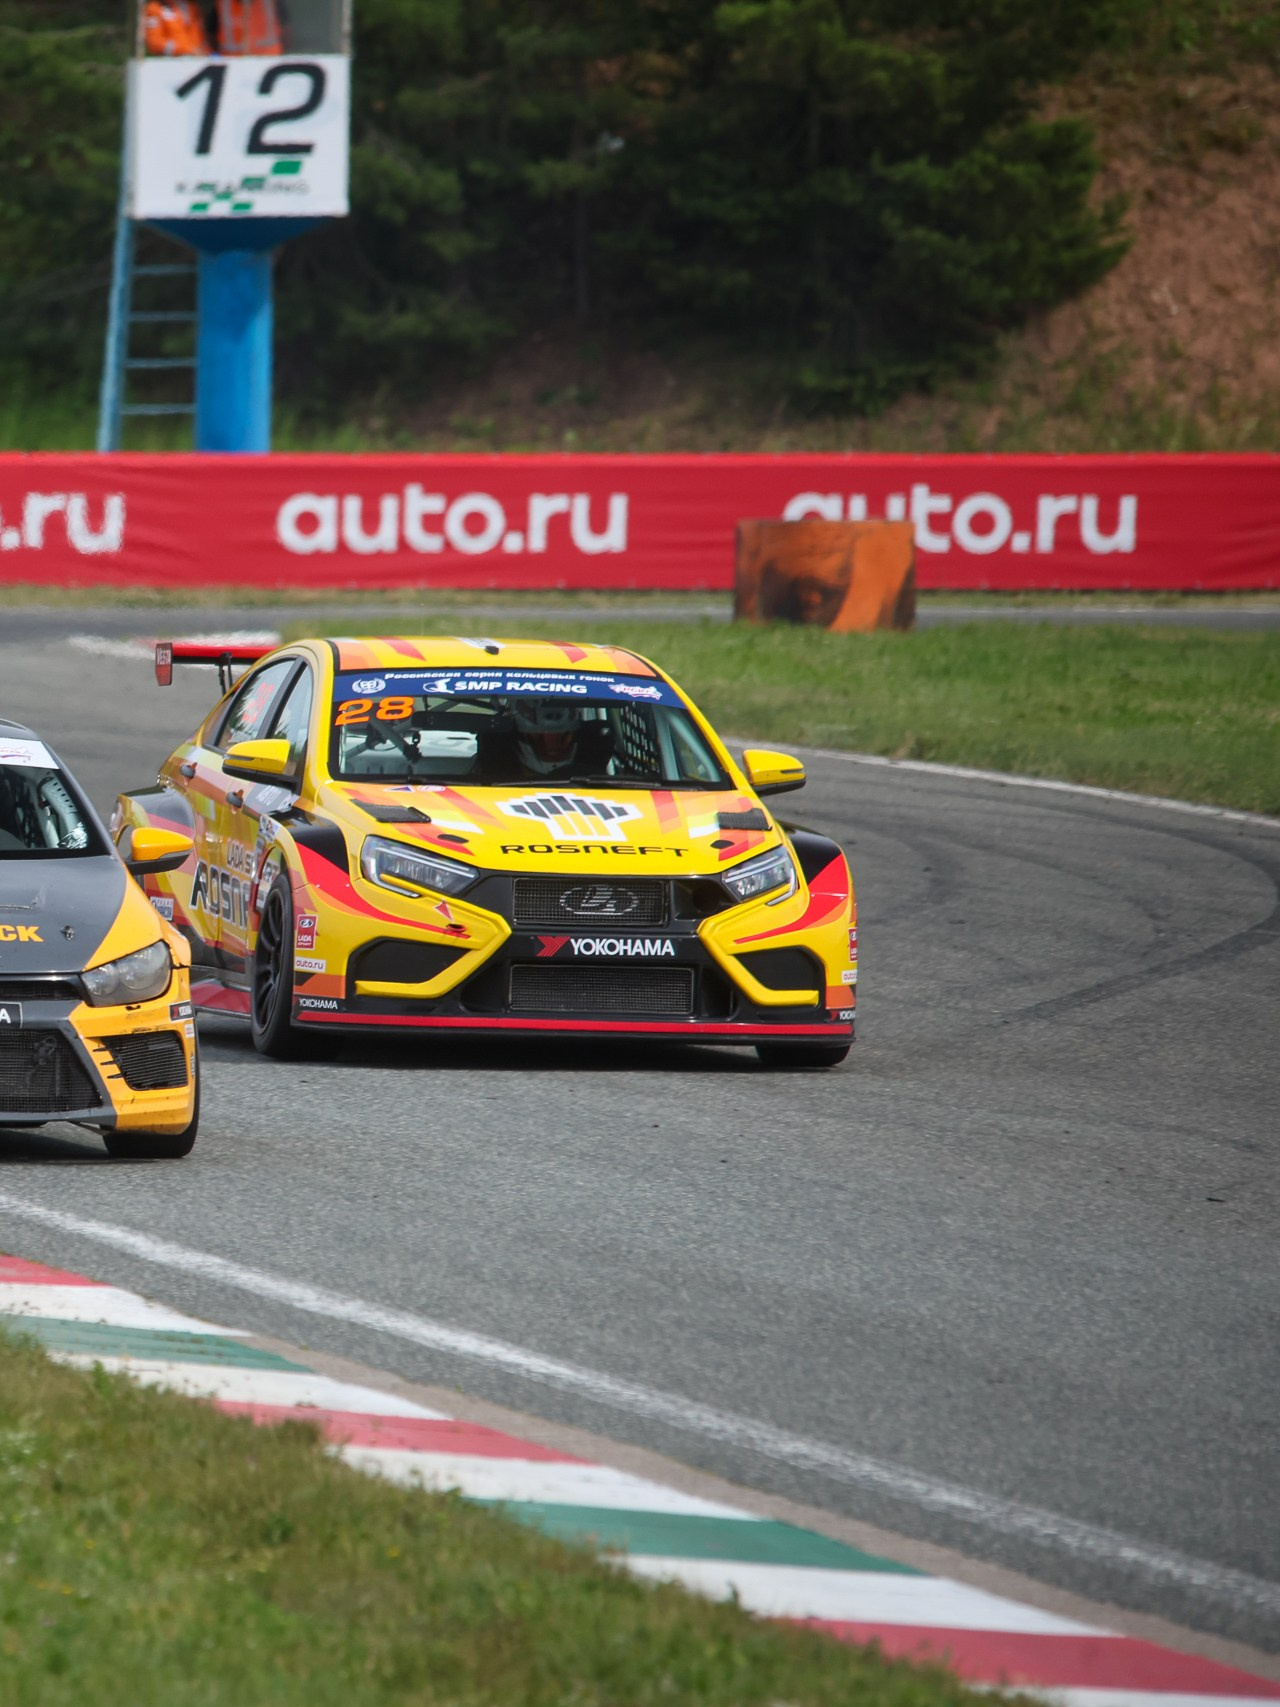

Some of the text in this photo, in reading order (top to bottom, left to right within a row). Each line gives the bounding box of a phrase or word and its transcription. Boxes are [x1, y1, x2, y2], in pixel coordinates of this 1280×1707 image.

[175, 62, 327, 156] 12
[276, 482, 629, 554] auto.ru
[454, 681, 588, 694] SMP RACING
[334, 696, 415, 726] 28
[499, 844, 689, 857] ROSNEFT
[297, 934, 312, 942] LADA
[570, 938, 675, 956] YOKOHAMA
[296, 959, 324, 970] auto.ru
[299, 998, 338, 1009] YOKOHAMA
